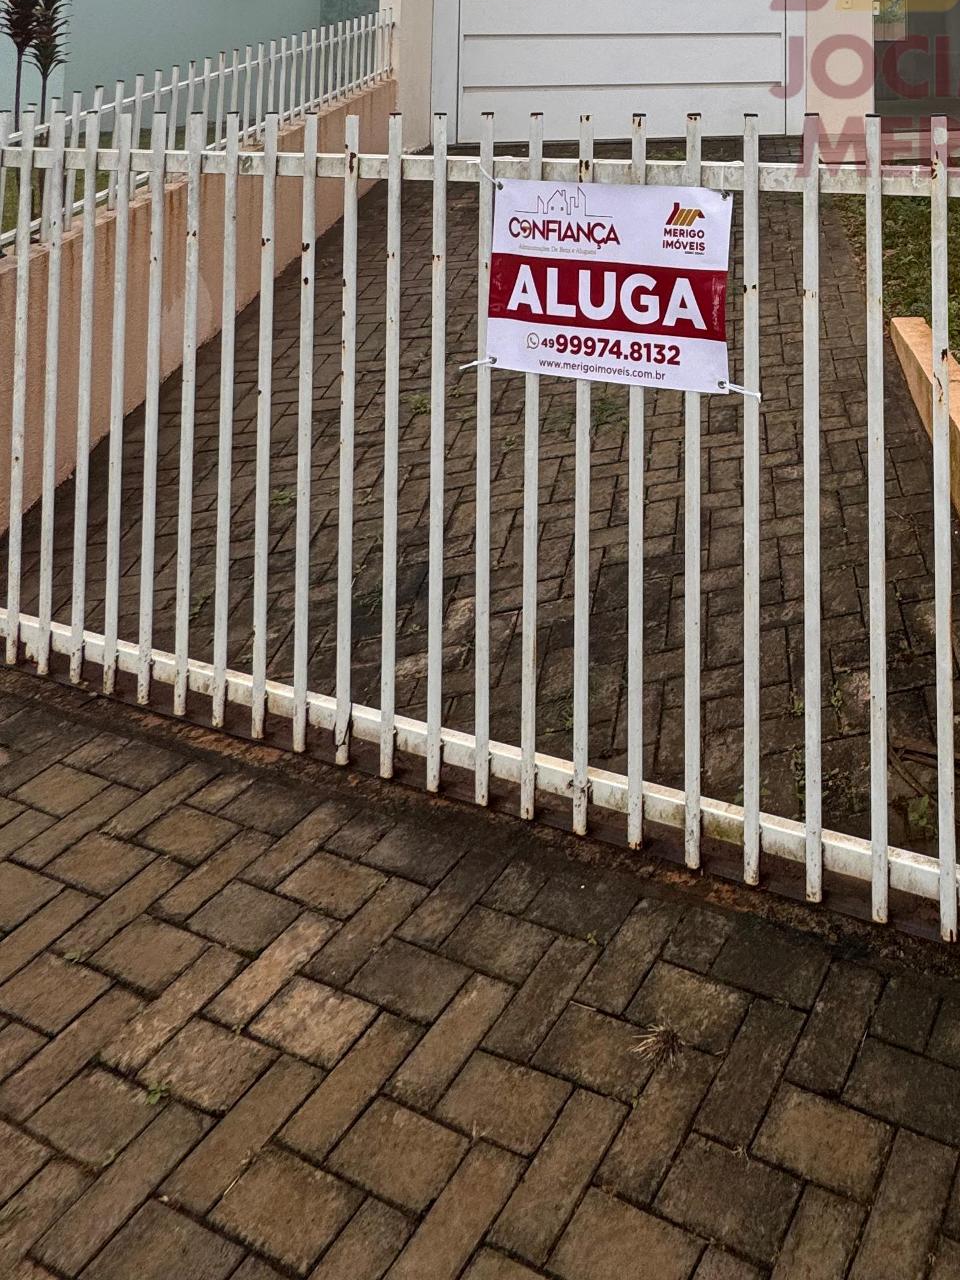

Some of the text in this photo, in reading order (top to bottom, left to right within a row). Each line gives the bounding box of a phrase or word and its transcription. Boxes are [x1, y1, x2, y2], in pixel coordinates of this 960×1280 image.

[508, 216, 620, 249] CONFIANÇA
[662, 238, 706, 251] IMÓVEIS
[663, 227, 705, 239] MERIGO
[506, 264, 708, 331] ALUGA
[540, 333, 681, 366] 49 99974.8132
[538, 359, 666, 381] www.merigoimoveis.com.br
